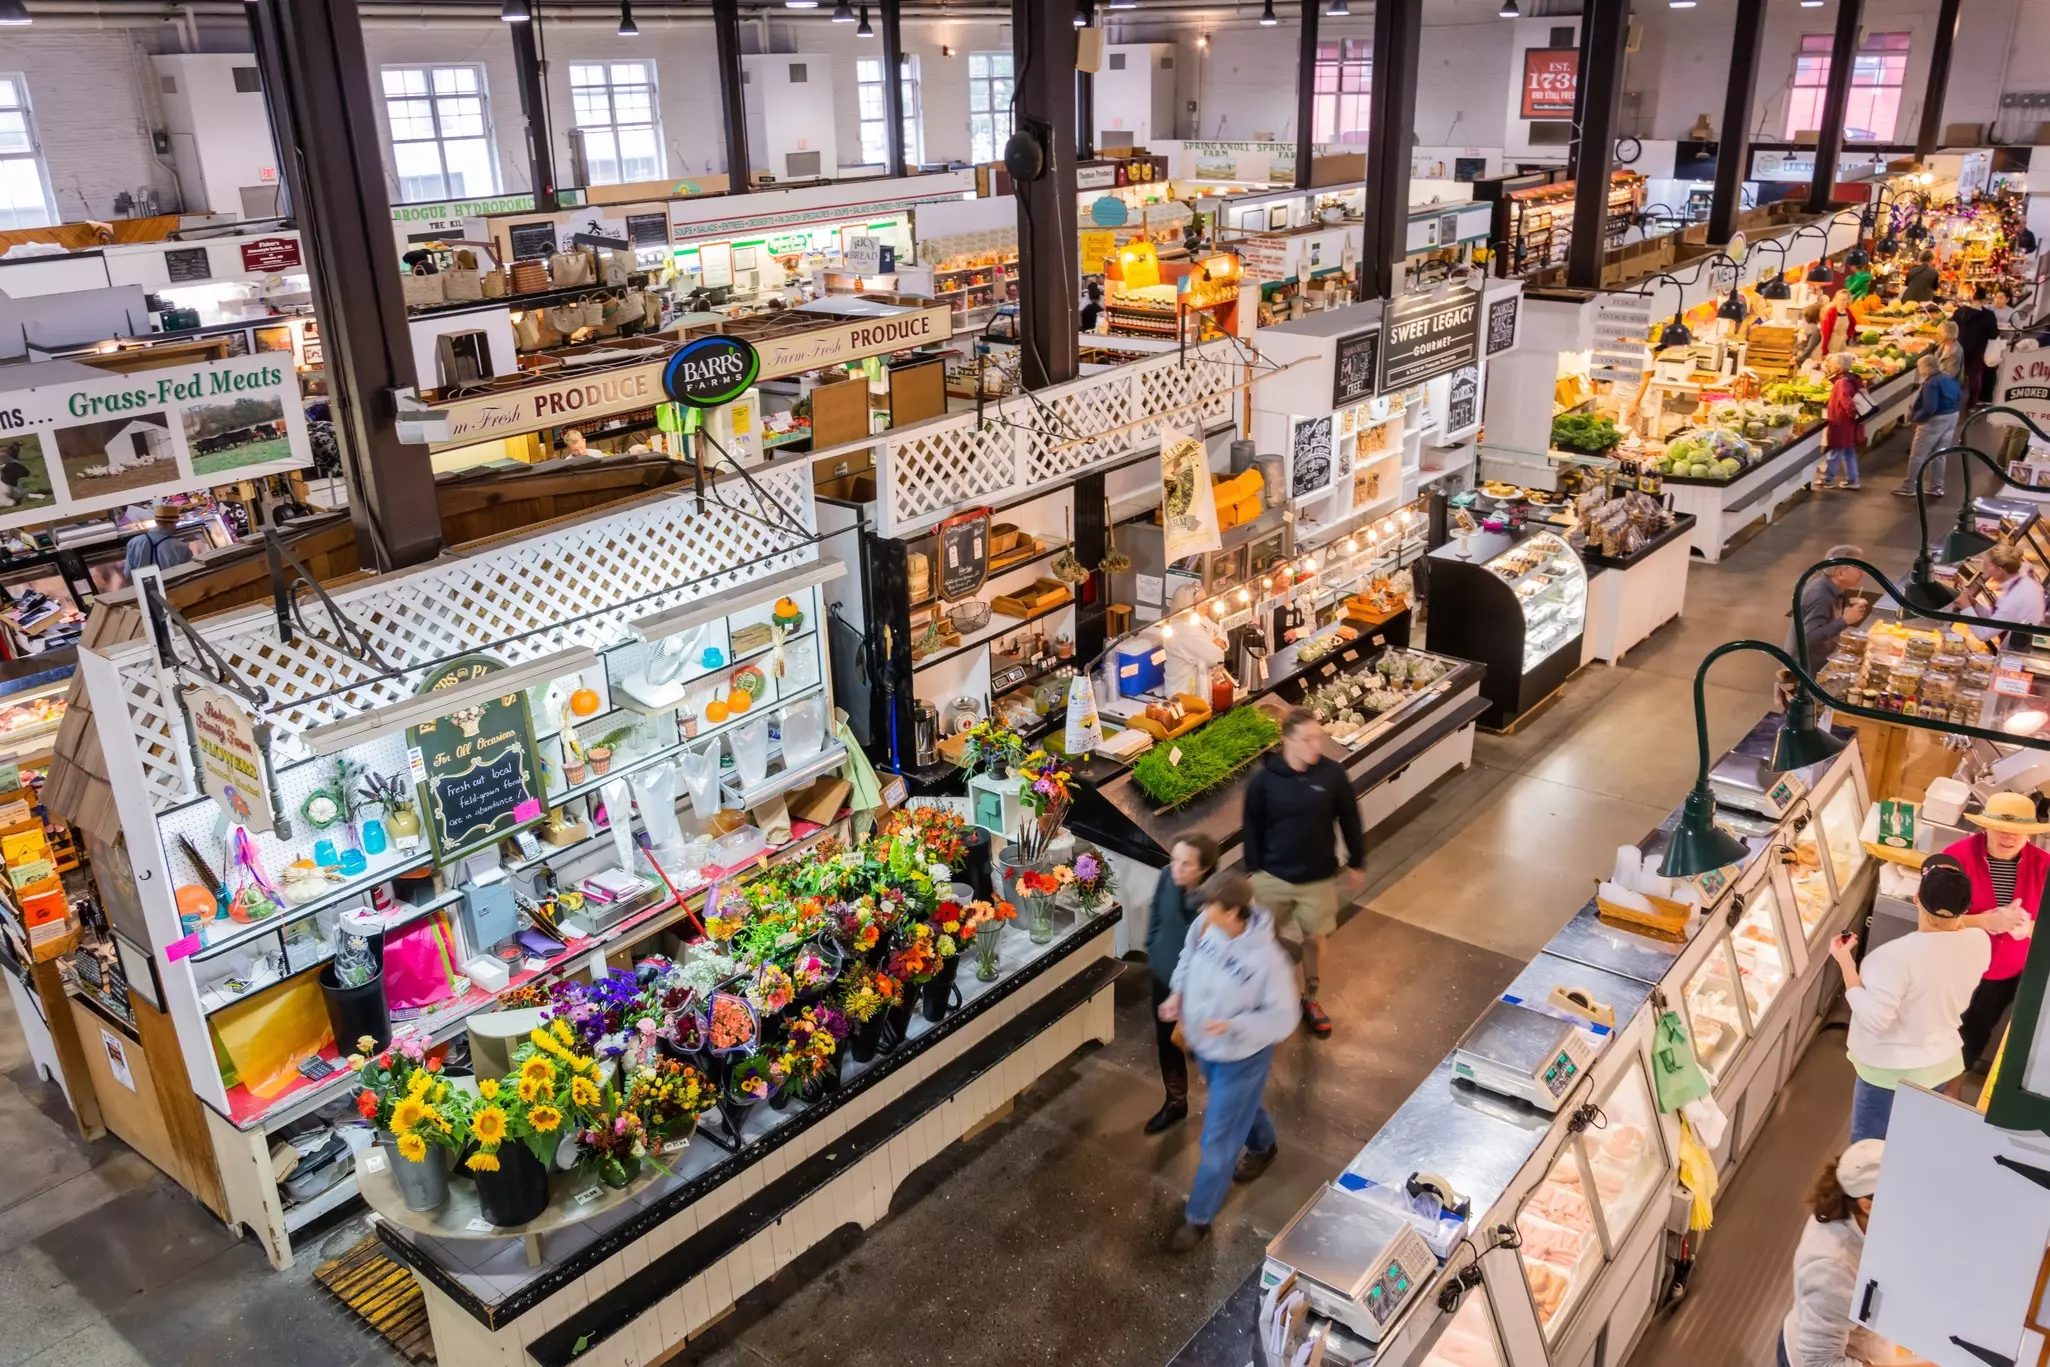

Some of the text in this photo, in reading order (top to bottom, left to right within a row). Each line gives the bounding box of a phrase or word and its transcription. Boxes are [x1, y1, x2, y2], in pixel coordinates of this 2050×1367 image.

[1549, 62, 1571, 71] EST.
[1183, 142, 1250, 151] SPRING KNOLL
[1257, 143, 1293, 152] SPRING
[1278, 151, 1296, 159] FAR
[394, 205, 446, 223] BROGUE
[429, 221, 445, 230] THE
[674, 226, 693, 236] SOUPS
[696, 224, 718, 234] SALADS
[720, 221, 745, 231] ENTREES
[748, 217, 775, 227] DESSERTS
[850, 250, 878, 260] BREAD
[1390, 306, 1475, 345] SWEET LEGACY
[768, 317, 930, 367] Farm Fresh PRODUCE
[1413, 336, 1452, 357] GOURMET
[68, 373, 204, 418] Grass-Fed
[209, 366, 283, 396] Meats
[2010, 388, 2048, 399] SMOKED
[472, 375, 649, 431] Fresh PRODUCE
[227, 729, 254, 756] Farm
[433, 729, 517, 767] For All Occasions
[199, 736, 259, 780] FLOWERS
[447, 763, 512, 797] Fresh cut local
[459, 788, 500, 808] field-grown
[449, 818, 464, 827] are
[475, 795, 514, 816] abundance
